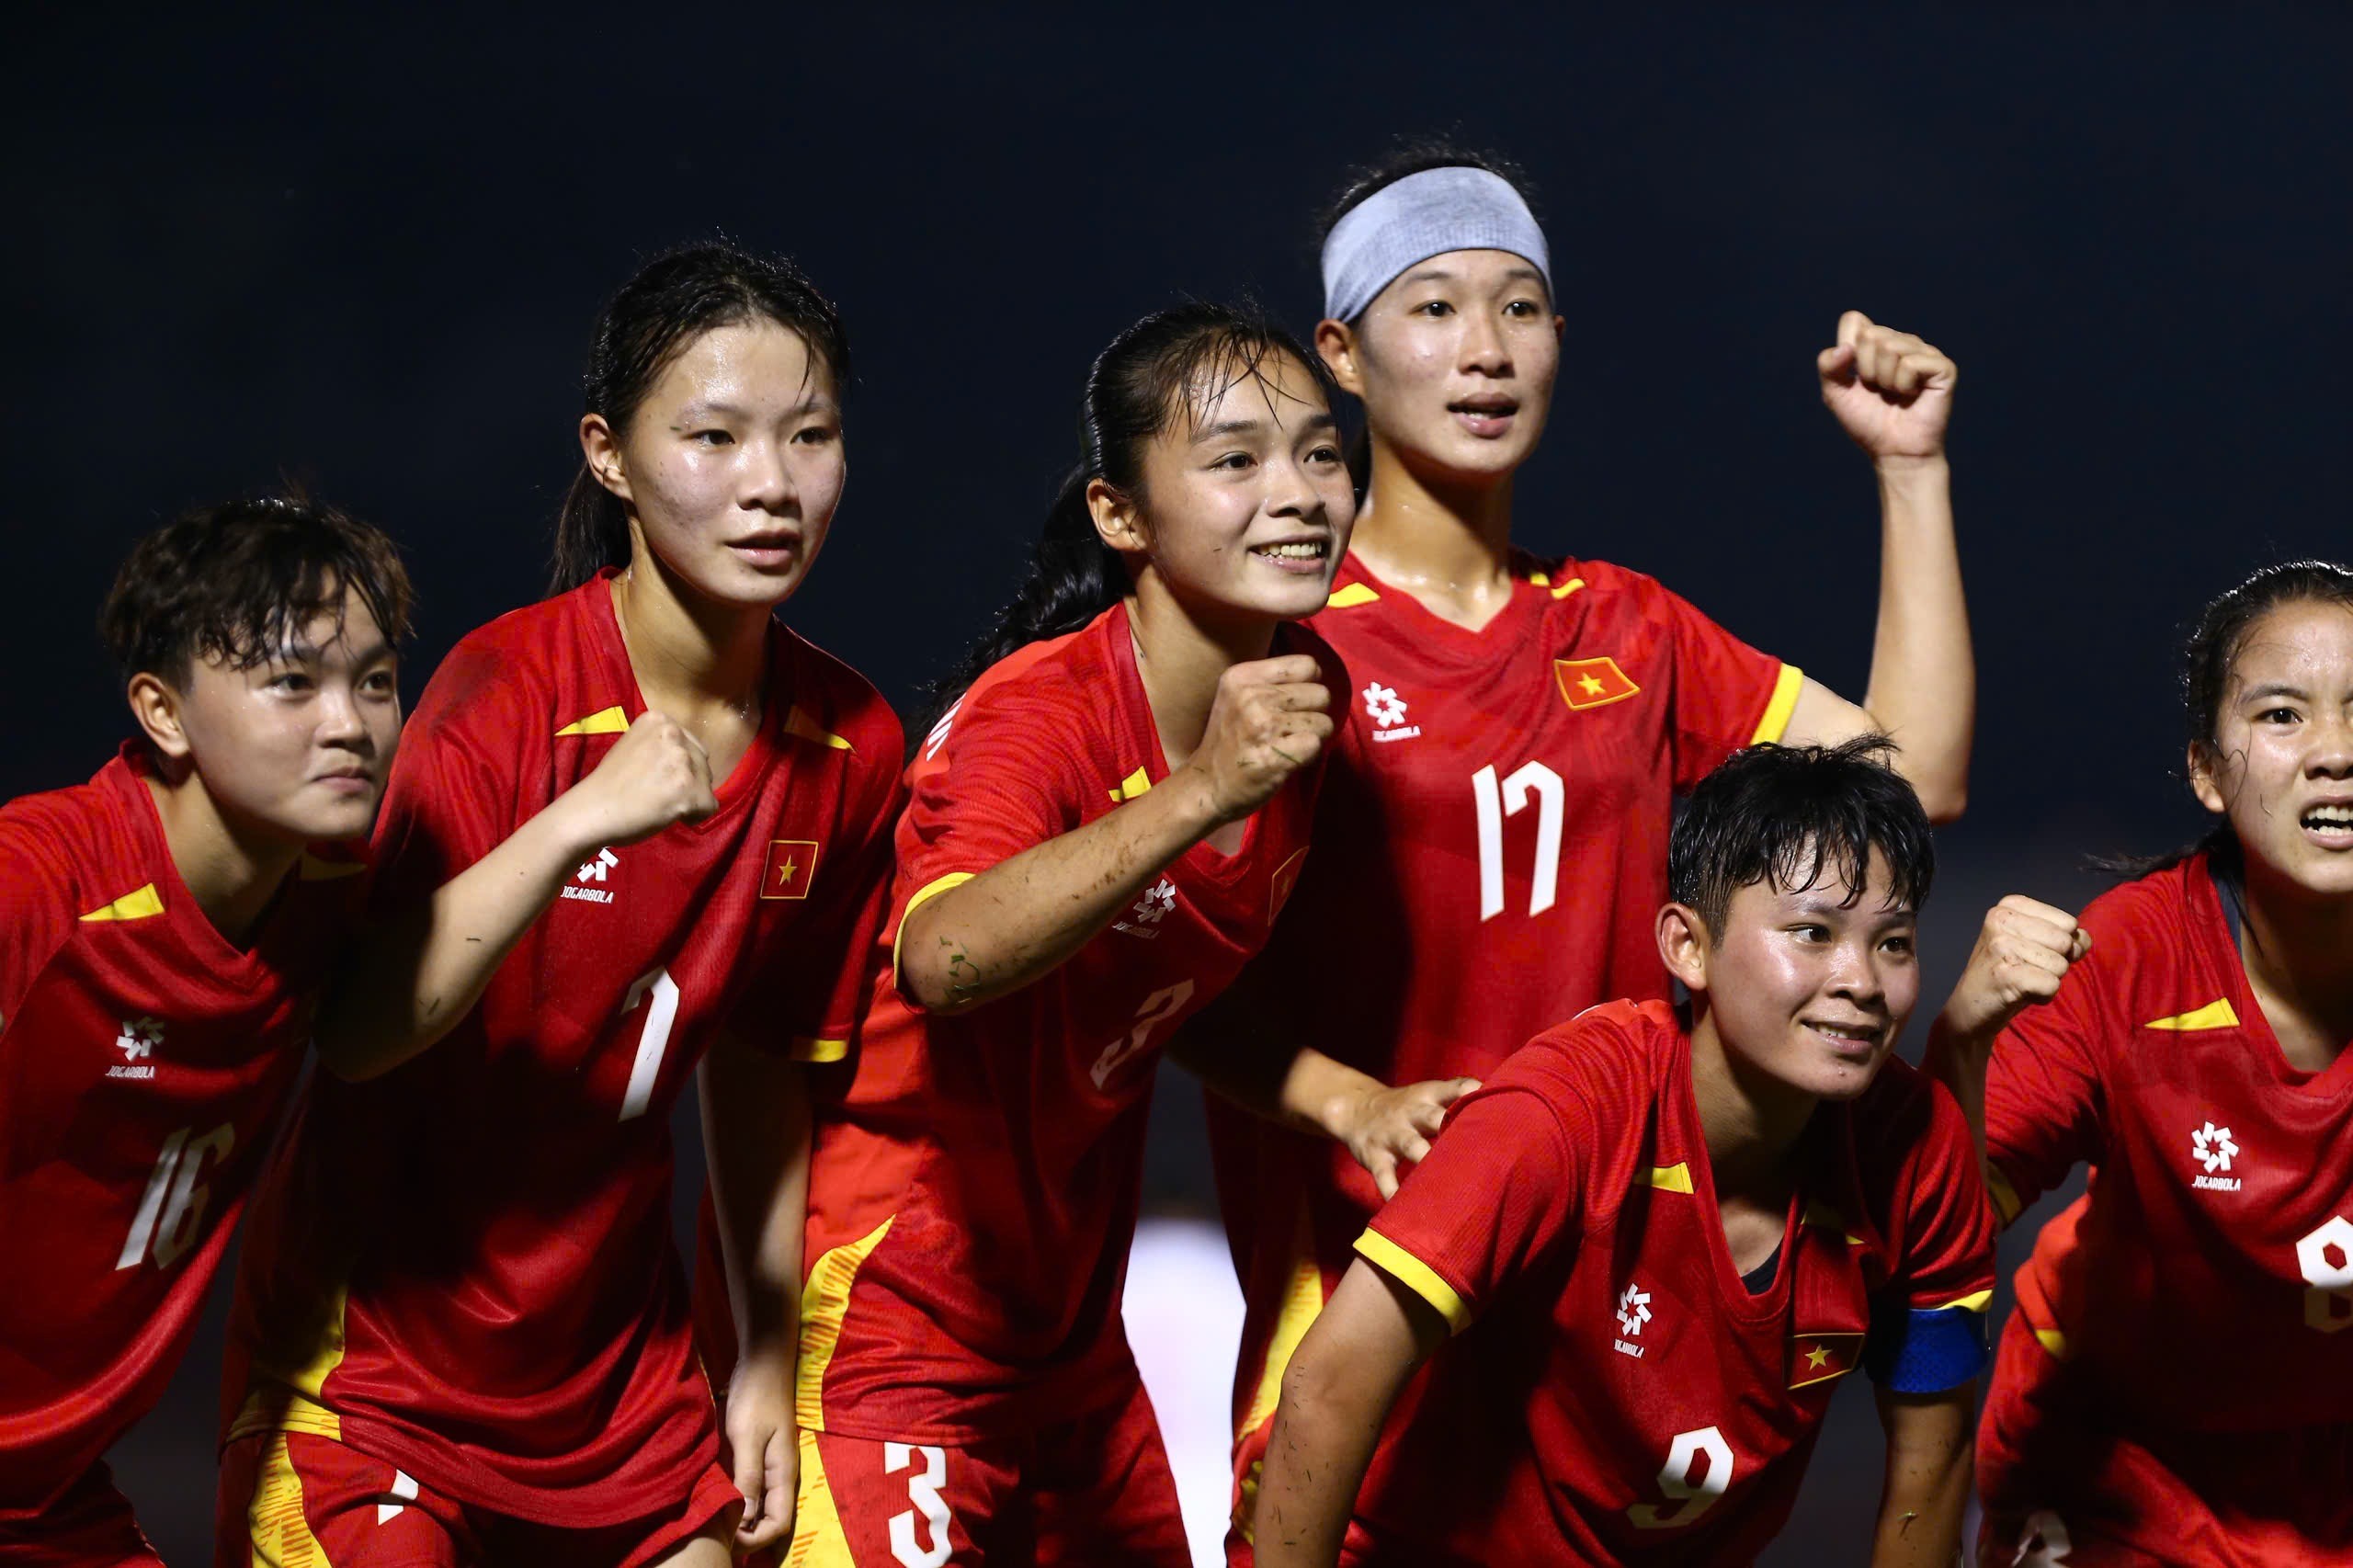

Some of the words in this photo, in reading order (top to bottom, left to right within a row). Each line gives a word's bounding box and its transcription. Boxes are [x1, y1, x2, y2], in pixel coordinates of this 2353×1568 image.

[560, 885, 614, 903] JOGARBOLA
[1472, 760, 1564, 922] 17
[1089, 979, 1194, 1091] 3
[115, 1120, 235, 1270] 16
[2295, 1215, 2353, 1334] 8
[884, 1441, 952, 1568] 3
[1626, 1426, 1734, 1528] 9
